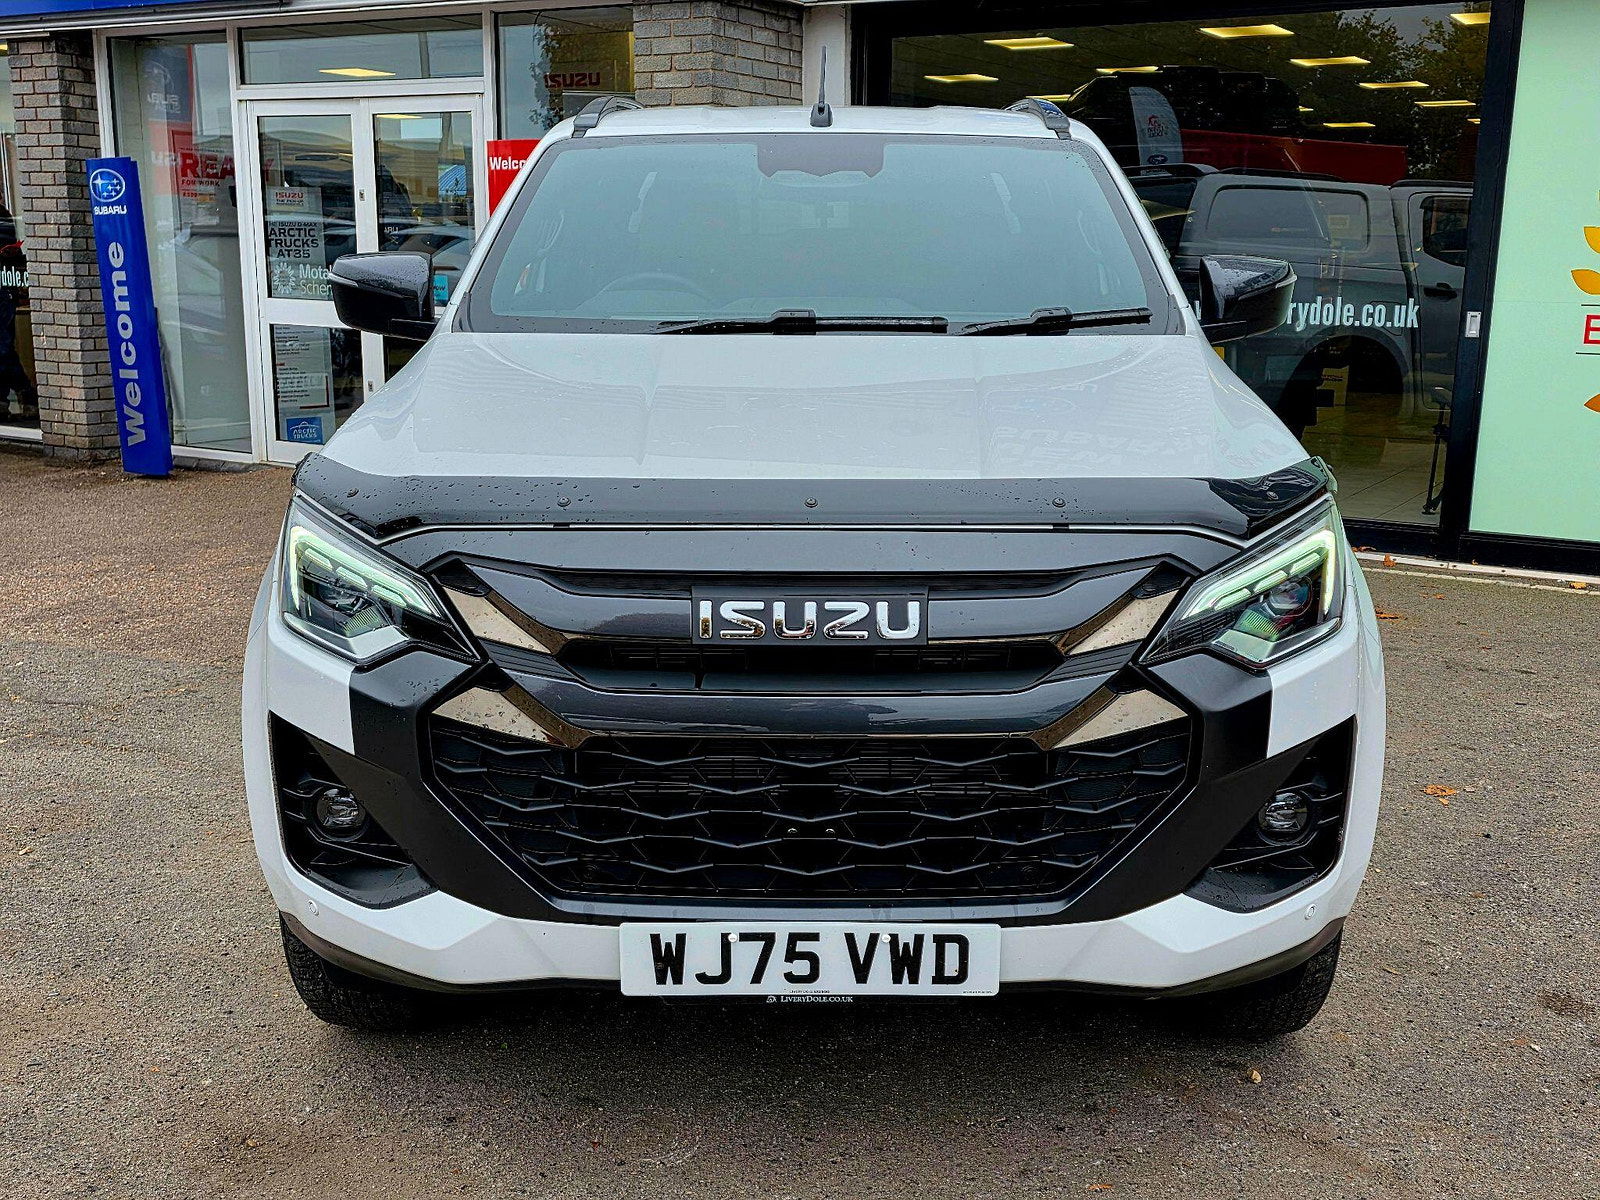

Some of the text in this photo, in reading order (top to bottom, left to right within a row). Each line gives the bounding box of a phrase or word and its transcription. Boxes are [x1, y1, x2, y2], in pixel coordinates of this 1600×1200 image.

[543, 72, 600, 88] ISUZU
[275, 191, 304, 199] ISUZU
[93, 205, 127, 215] SUBARU
[269, 227, 316, 238] ARCTIC
[268, 238, 320, 248] TRUCKS
[108, 241, 147, 446] Welcome
[699, 600, 921, 640] ISUZU
[649, 932, 970, 985] WJ75 VWD
